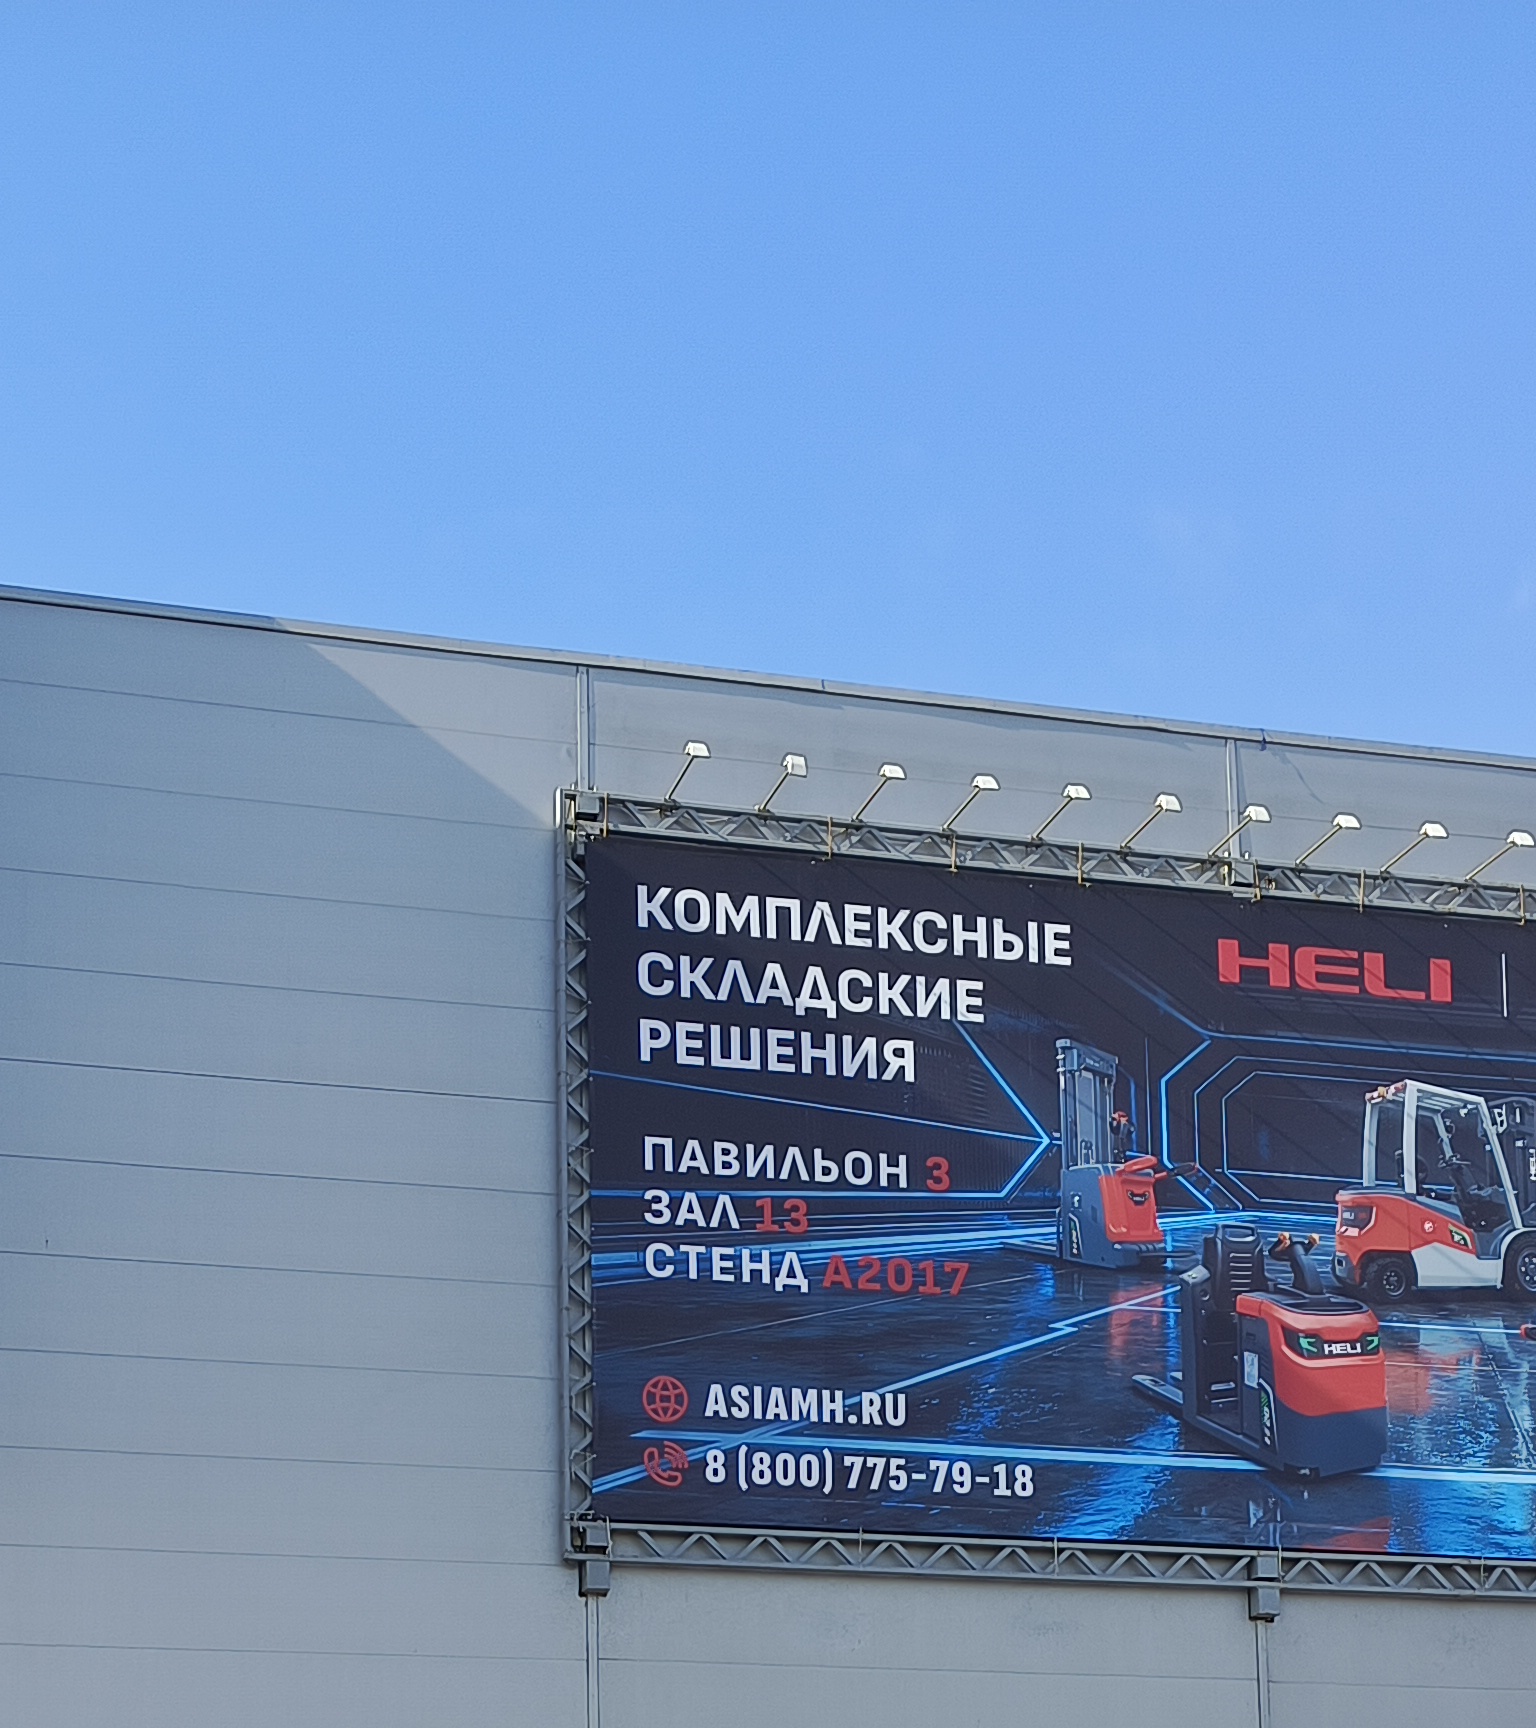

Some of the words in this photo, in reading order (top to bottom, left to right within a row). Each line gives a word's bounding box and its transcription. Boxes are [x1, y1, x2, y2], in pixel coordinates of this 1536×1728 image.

[637, 884, 1072, 967] КОМПЛЕКСНЫЕ
[637, 951, 985, 1023] СКЛАДСКИЕ
[1217, 938, 1453, 1003] HELI
[639, 1018, 916, 1083] РЕШЕНИЯ
[643, 1135, 908, 1189] ПАВИЛЬОН
[925, 1156, 950, 1191] 3
[643, 1189, 740, 1230] ЗАЛ
[755, 1197, 809, 1233] 13
[645, 1243, 809, 1293] СТЕНД
[1323, 1342, 1362, 1355] HELI
[704, 1383, 907, 1427] ASIAMH.RU
[705, 1449, 726, 1483] 8
[738, 1444, 834, 1495] (800)
[844, 1455, 1035, 1497] 775-79-18
